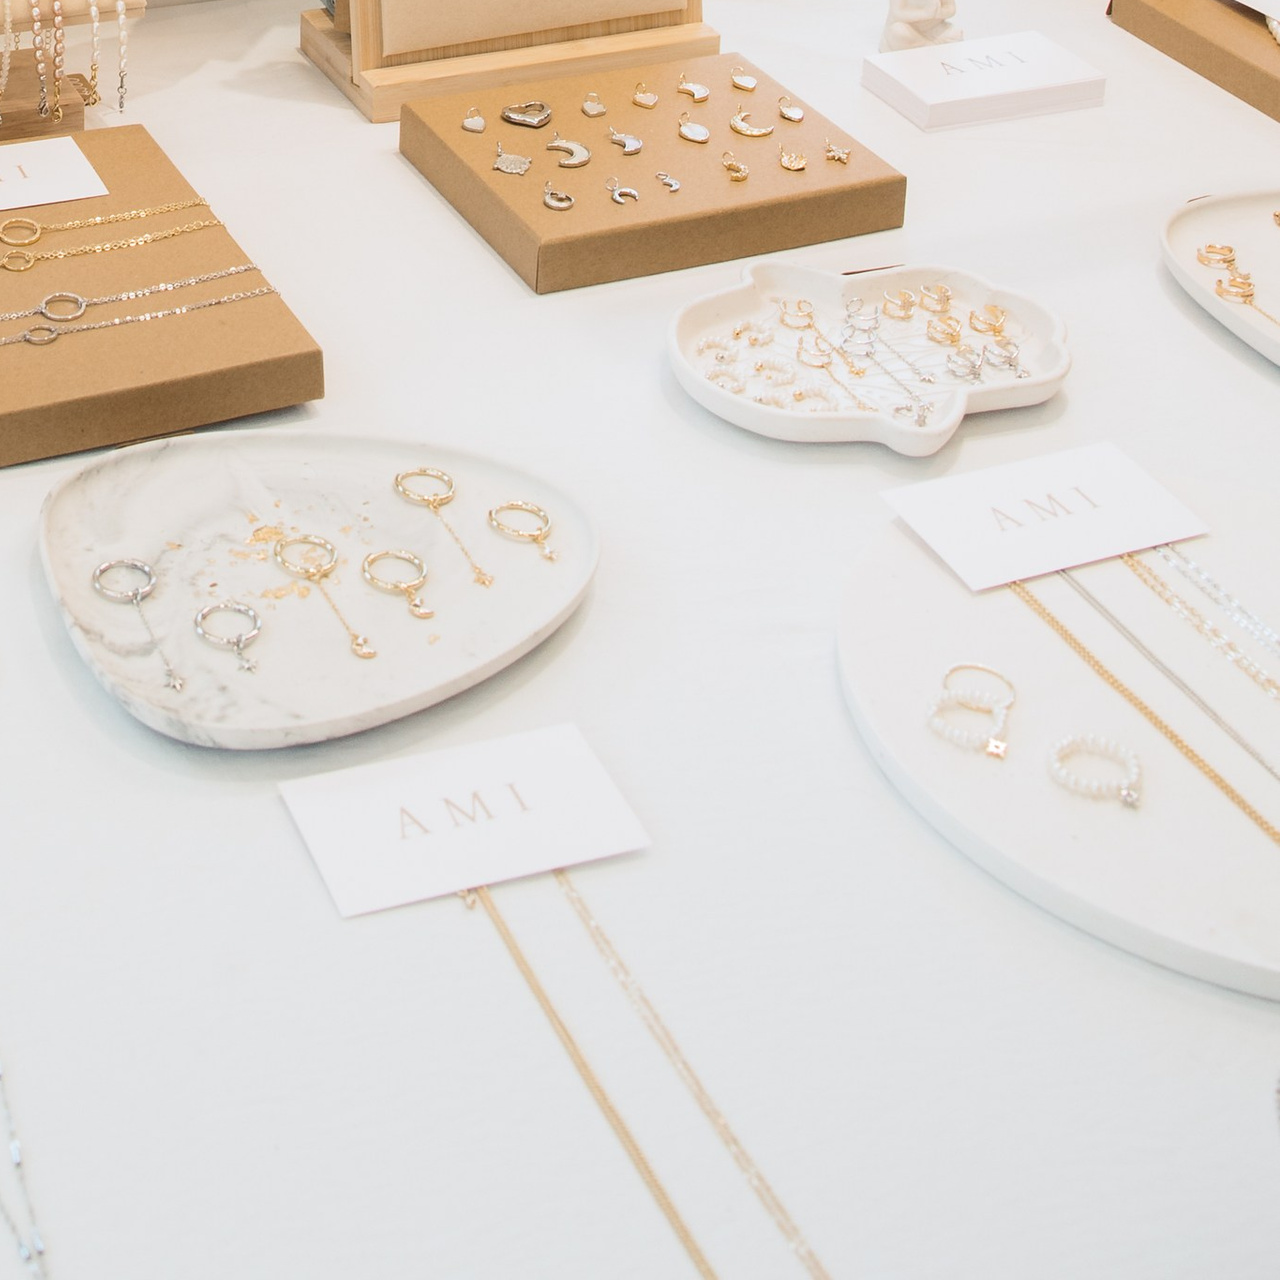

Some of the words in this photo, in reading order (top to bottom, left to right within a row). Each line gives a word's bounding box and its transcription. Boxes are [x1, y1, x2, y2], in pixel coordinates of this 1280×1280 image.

[939, 49, 1028, 77] AMI
[991, 485, 1101, 531] AMI
[397, 782, 531, 841] AMI
